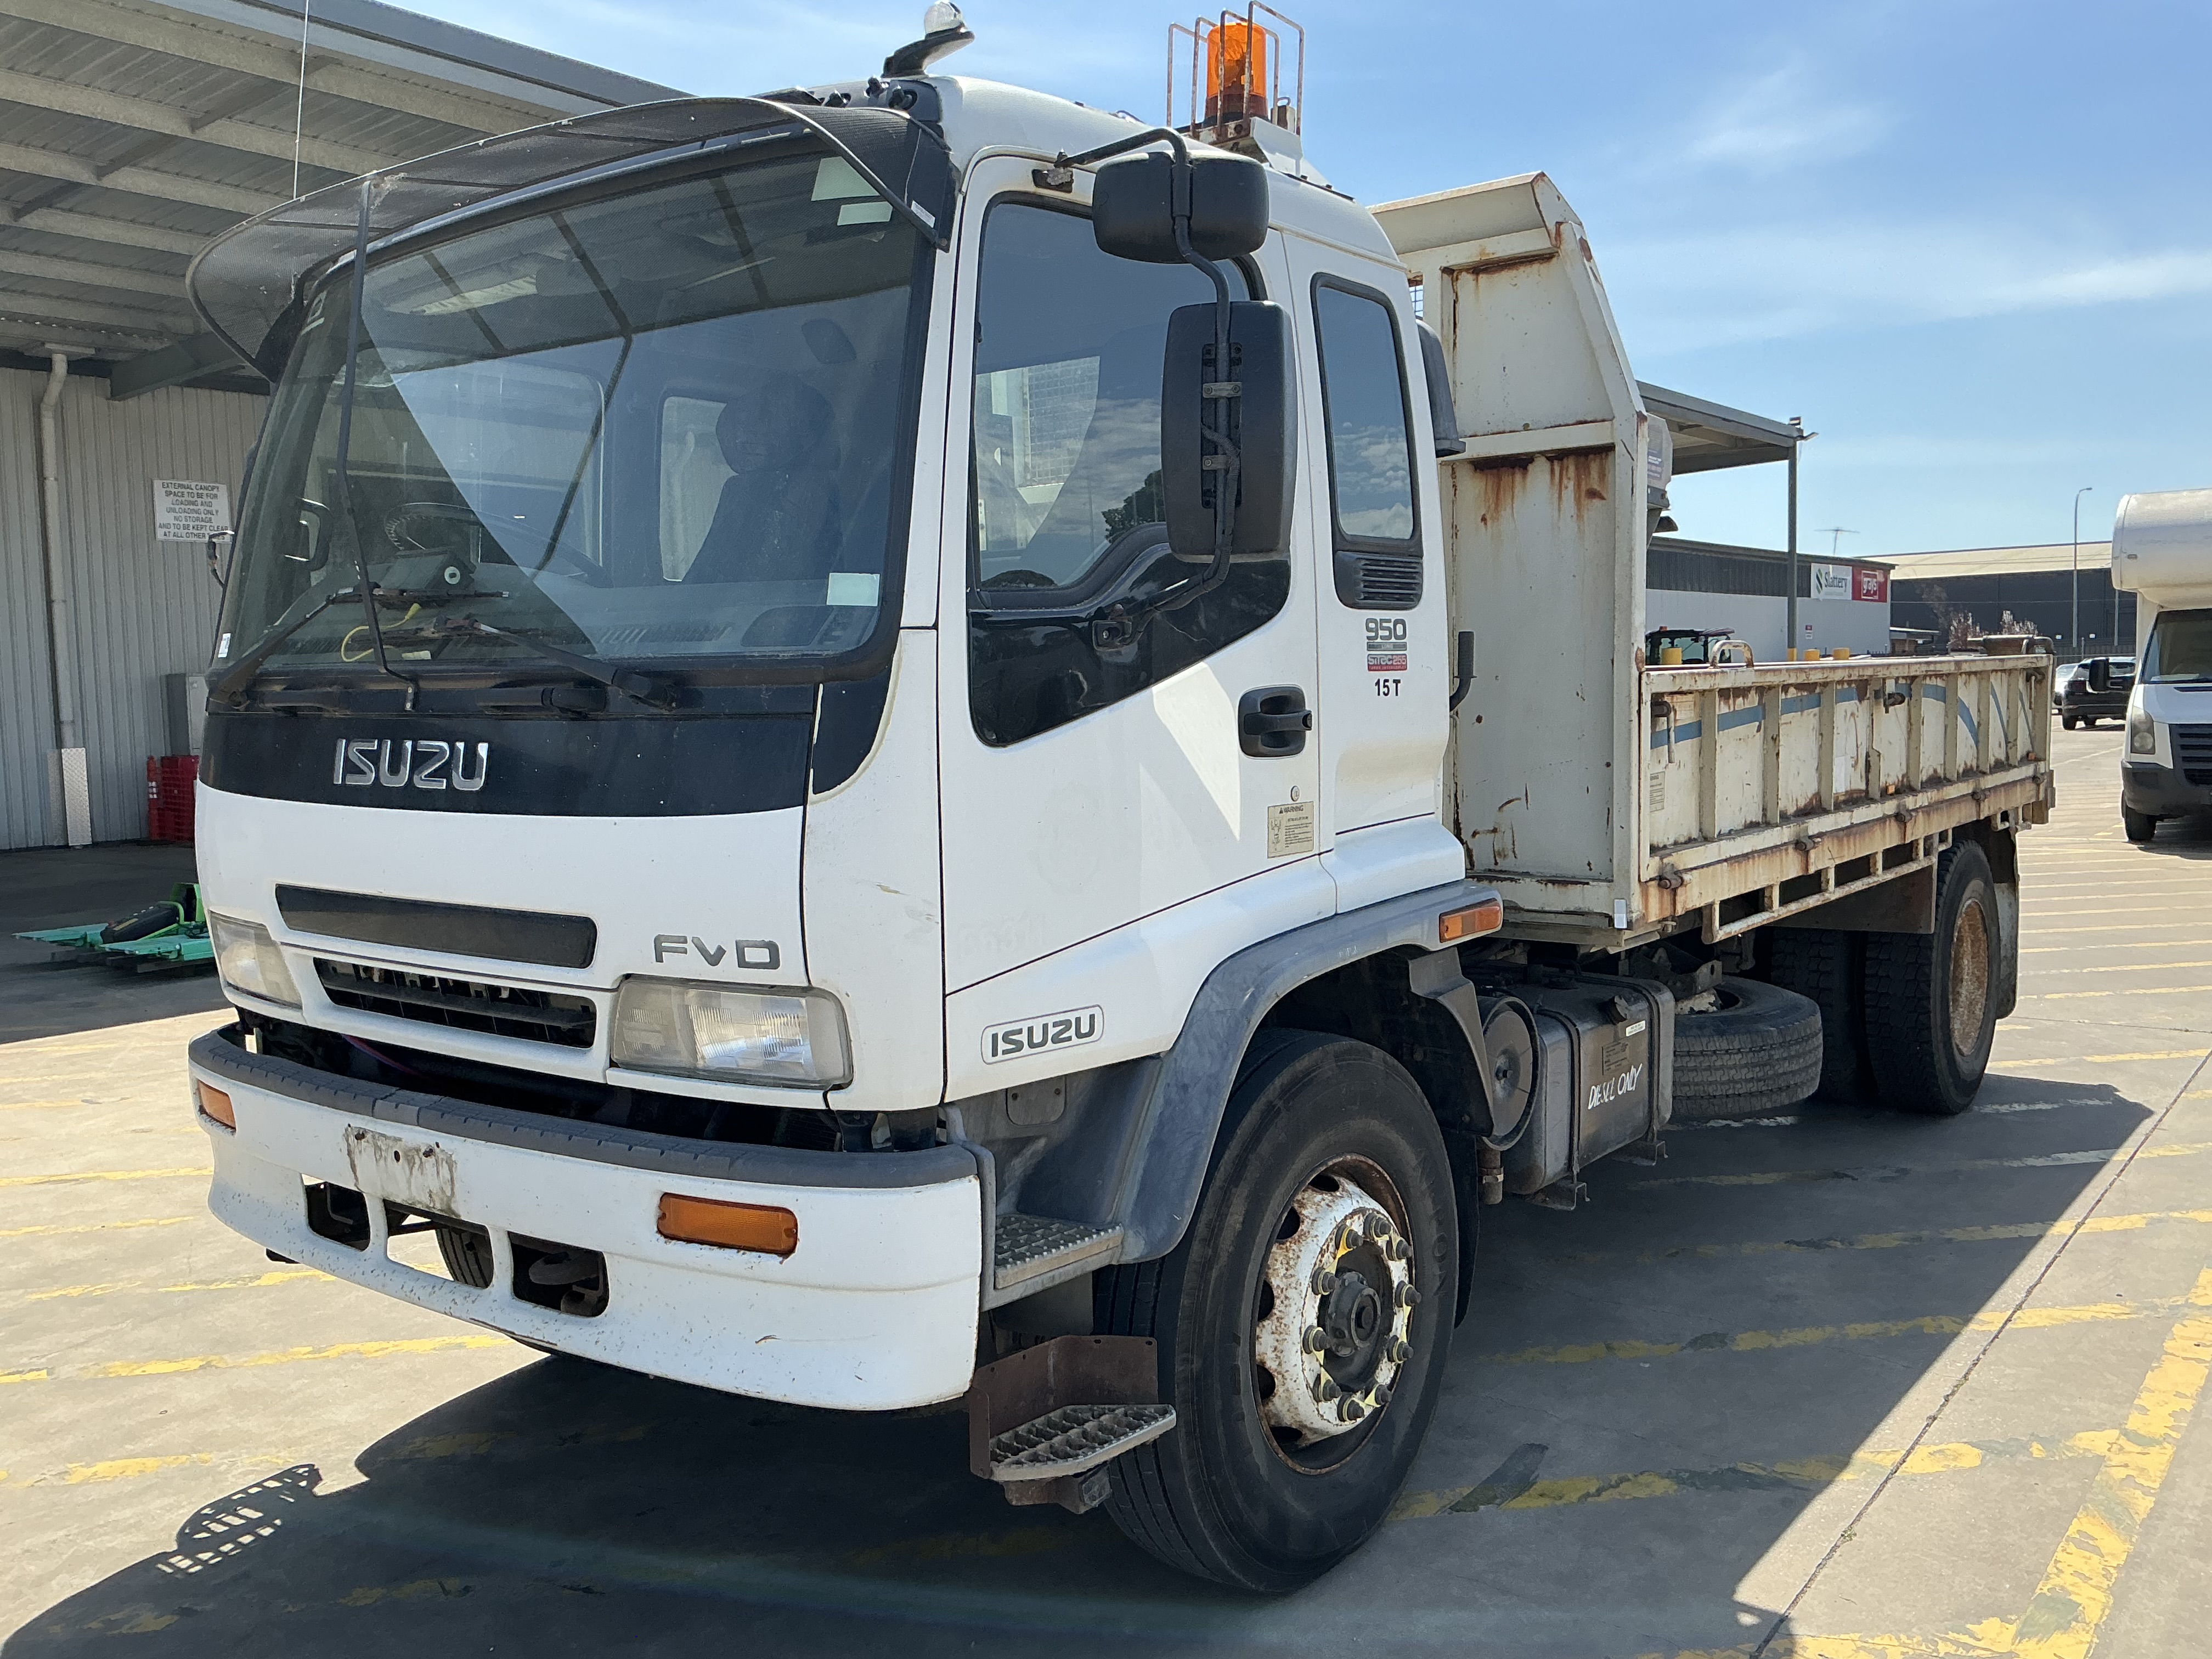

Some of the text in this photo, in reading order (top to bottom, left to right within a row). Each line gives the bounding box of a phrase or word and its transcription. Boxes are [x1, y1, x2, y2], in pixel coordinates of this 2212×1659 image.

[162, 482, 194, 490] EXTERNAL
[1825, 572, 1847, 592] Slattery
[1863, 577, 1877, 594] grays
[1365, 618, 1407, 641] 950
[333, 738, 489, 791] ISUZU
[1283, 805, 1304, 814] WARNING
[654, 934, 780, 969] FVD
[991, 1014, 1095, 1057] ISUZU
[1588, 1063, 1643, 1110] DIESEL ONLY
